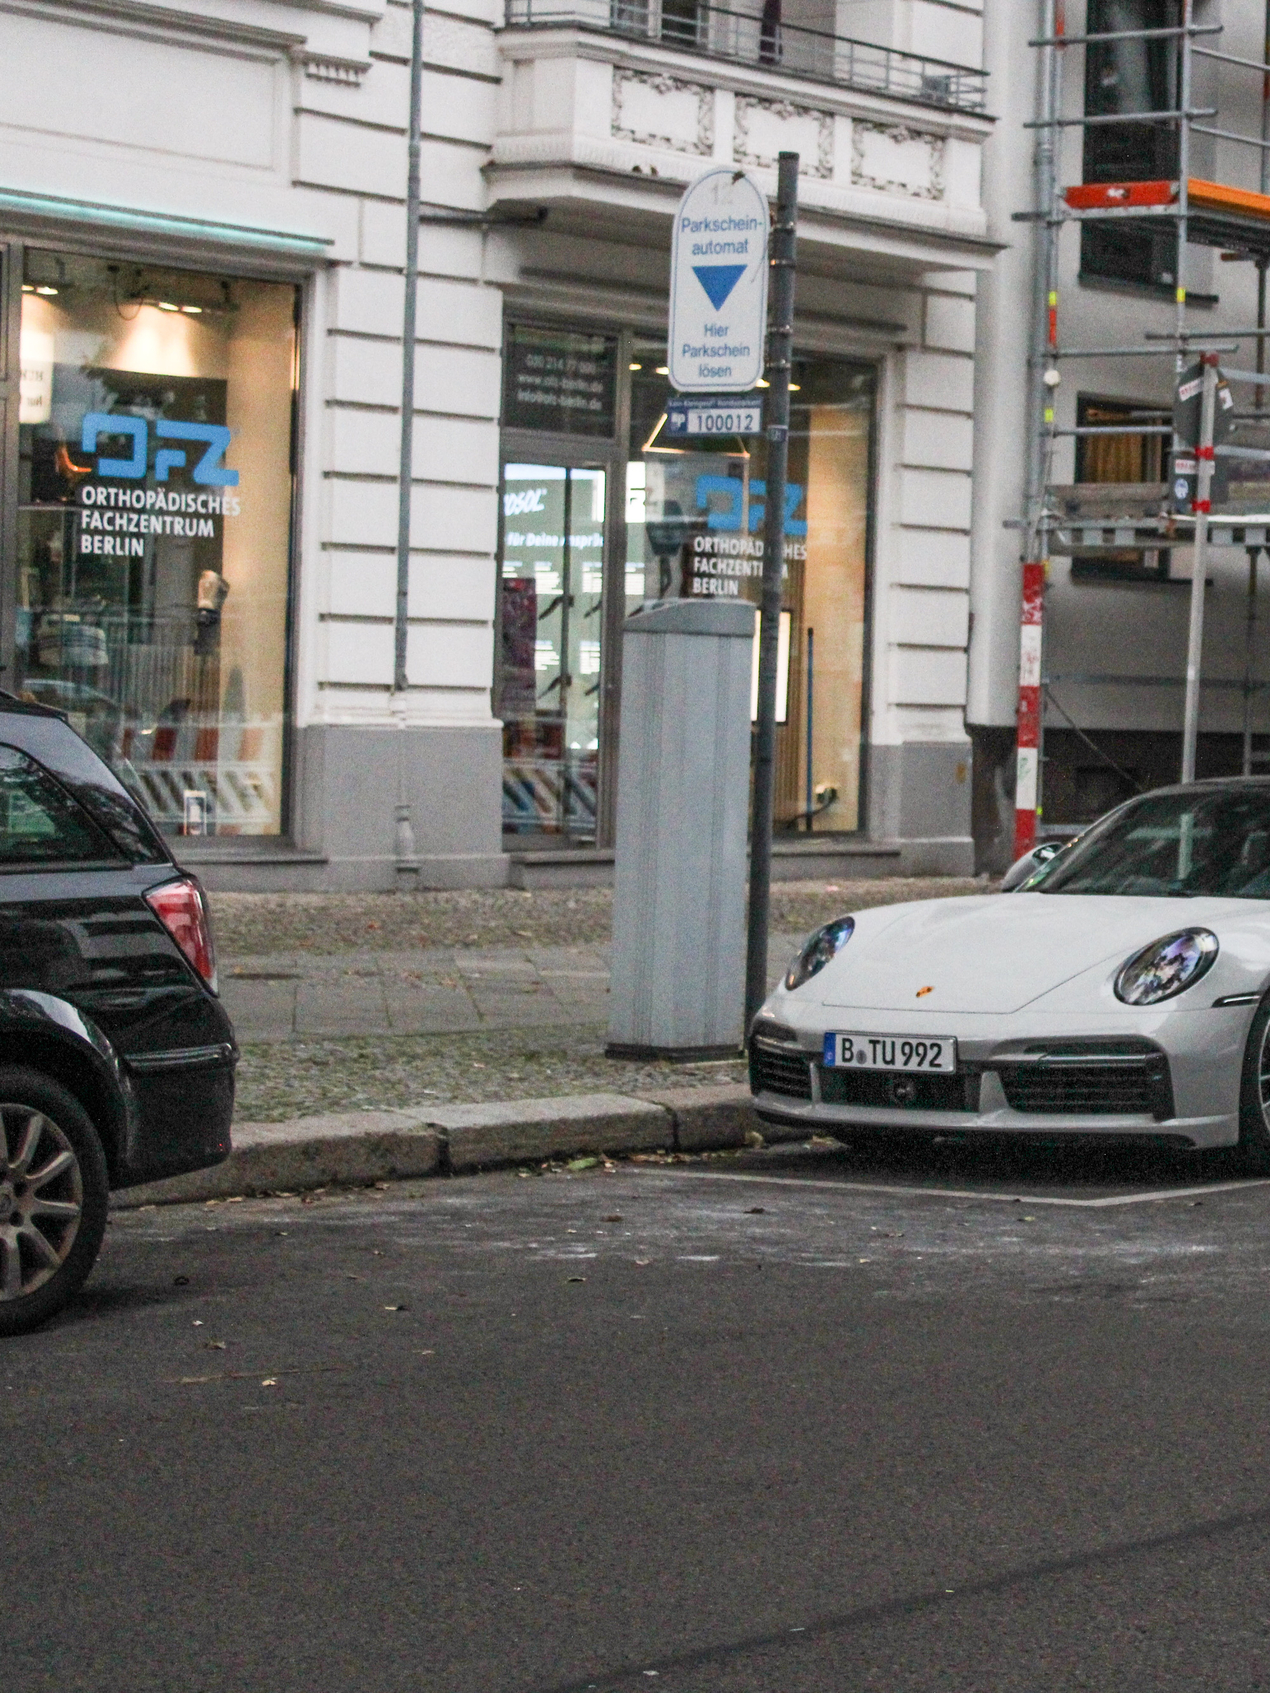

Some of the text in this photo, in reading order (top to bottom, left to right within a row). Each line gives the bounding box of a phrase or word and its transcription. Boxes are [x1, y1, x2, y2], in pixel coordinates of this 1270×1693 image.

[682, 214, 766, 233] Parkschein-
[691, 239, 748, 256] automat
[703, 323, 729, 337] Hier
[682, 343, 751, 358] Parkschein
[698, 363, 732, 378] lösen
[697, 413, 754, 432] 100012
[82, 486, 241, 516] ORTHOPÄDISCHES
[82, 510, 215, 538] FACHZENTRUM
[81, 534, 144, 557] BERLIN
[525, 532, 559, 546] Deine
[693, 577, 739, 596] BERLIN
[841, 1037, 943, 1068] B TU 992
